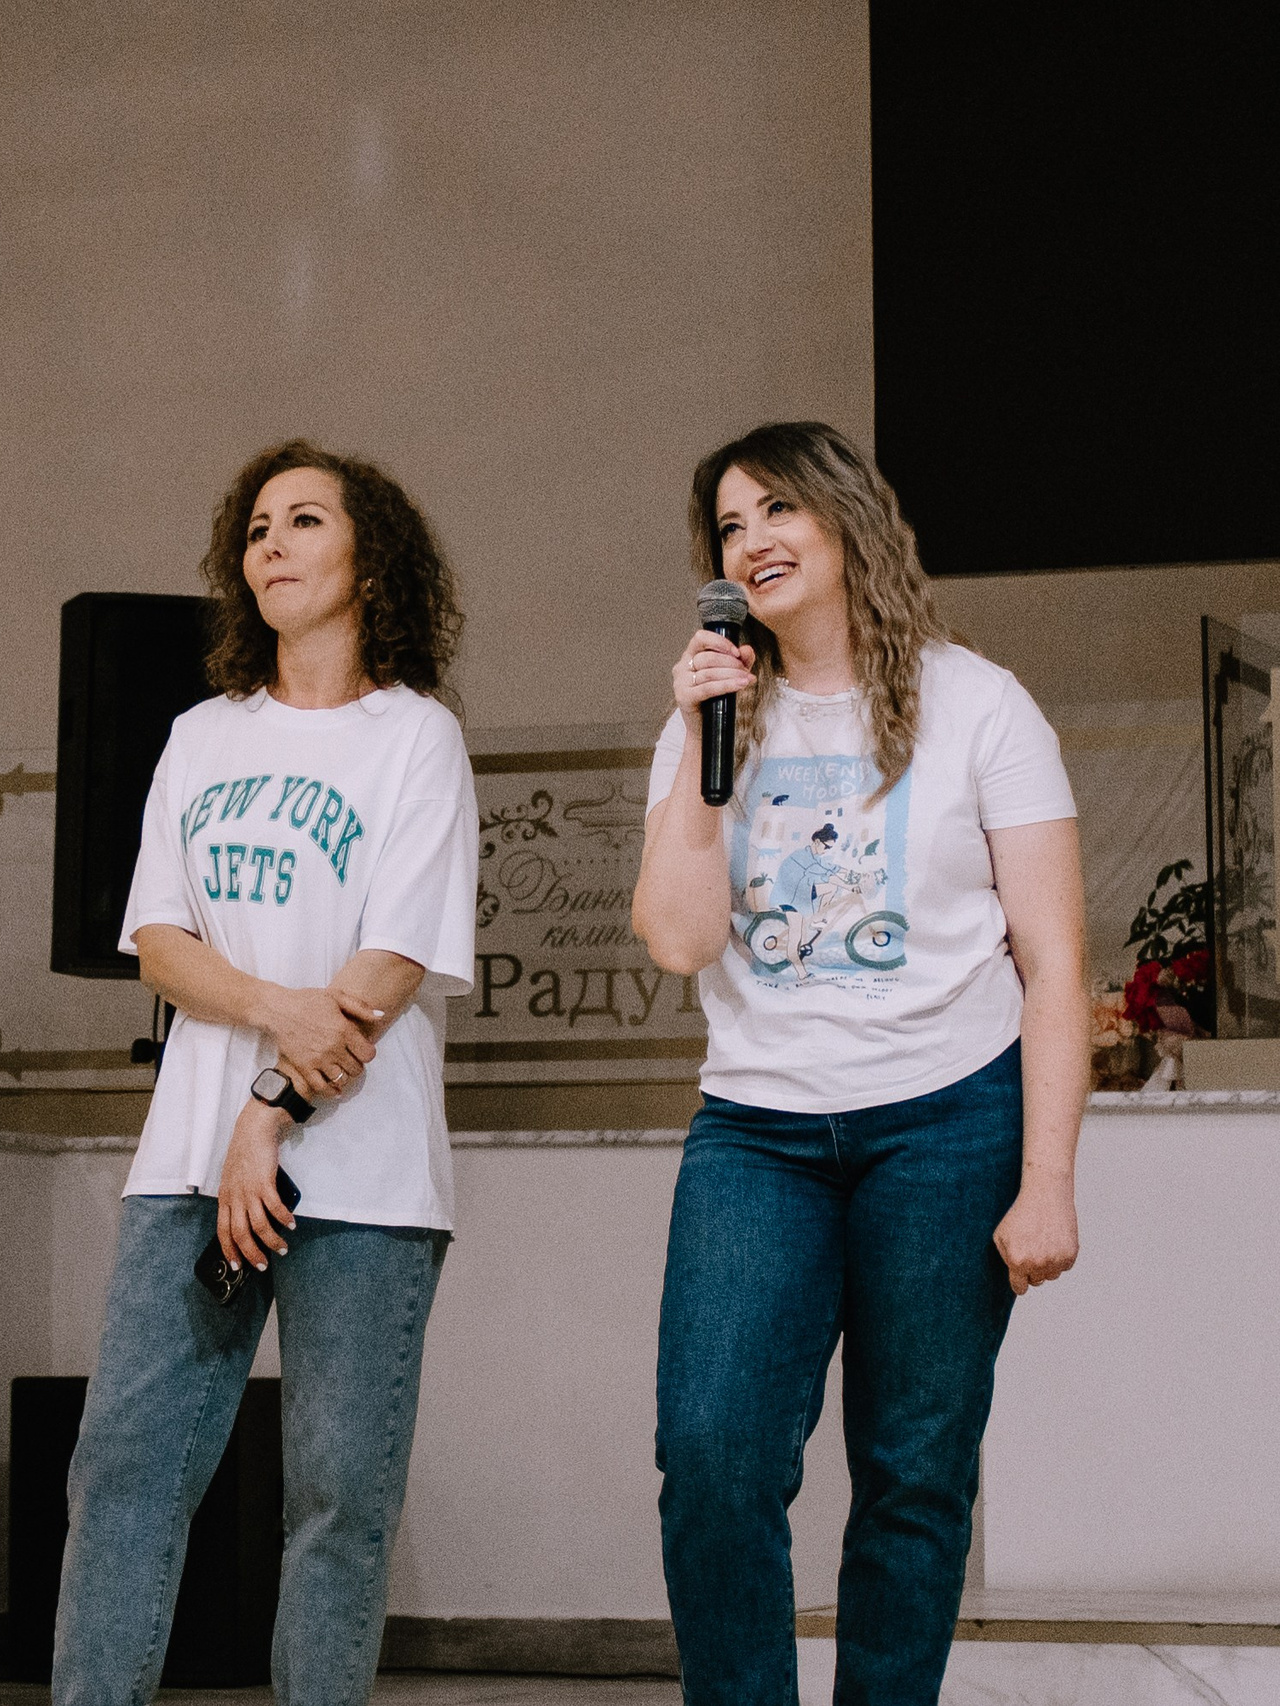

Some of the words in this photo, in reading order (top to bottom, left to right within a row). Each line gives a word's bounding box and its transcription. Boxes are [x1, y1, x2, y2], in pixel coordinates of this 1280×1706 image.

[803, 781, 856, 801] MOOD
[181, 775, 273, 855] NEW
[270, 775, 365, 887] YORK
[204, 843, 297, 906] JETS
[499, 850, 632, 919] Банк
